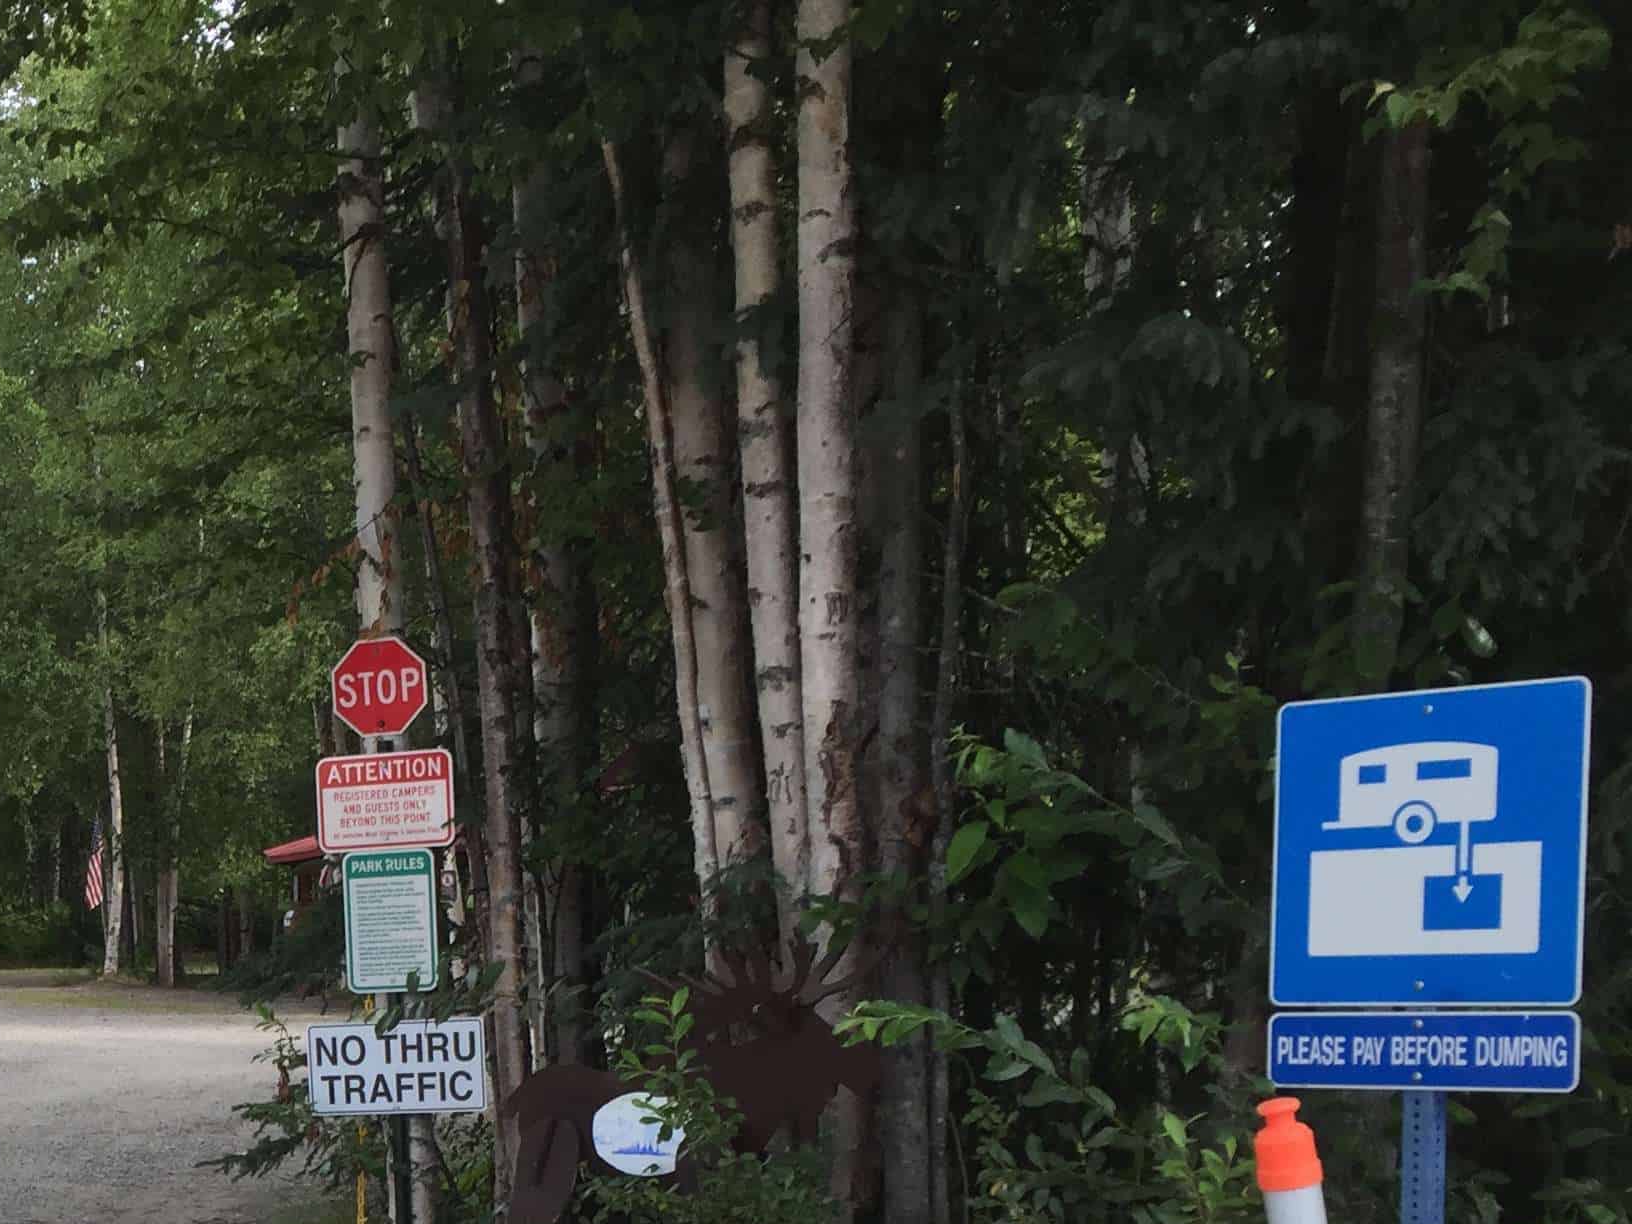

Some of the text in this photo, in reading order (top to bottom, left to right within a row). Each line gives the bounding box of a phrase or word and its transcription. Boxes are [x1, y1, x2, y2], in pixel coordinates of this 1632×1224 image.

[338, 667, 420, 708] STOP
[327, 757, 442, 784] ATTENTION
[334, 785, 436, 801] REGISTERED CAMPERS
[340, 813, 431, 827] BEYOND THIS POINT
[343, 800, 426, 814] AND GUESTS ONLY
[351, 857, 424, 874] PARK RULES
[315, 1032, 476, 1066] NO THRU
[1278, 1036, 1568, 1067] PLEASE PAY BEFORE DUMPING
[320, 1071, 473, 1105] TRAFFIC
